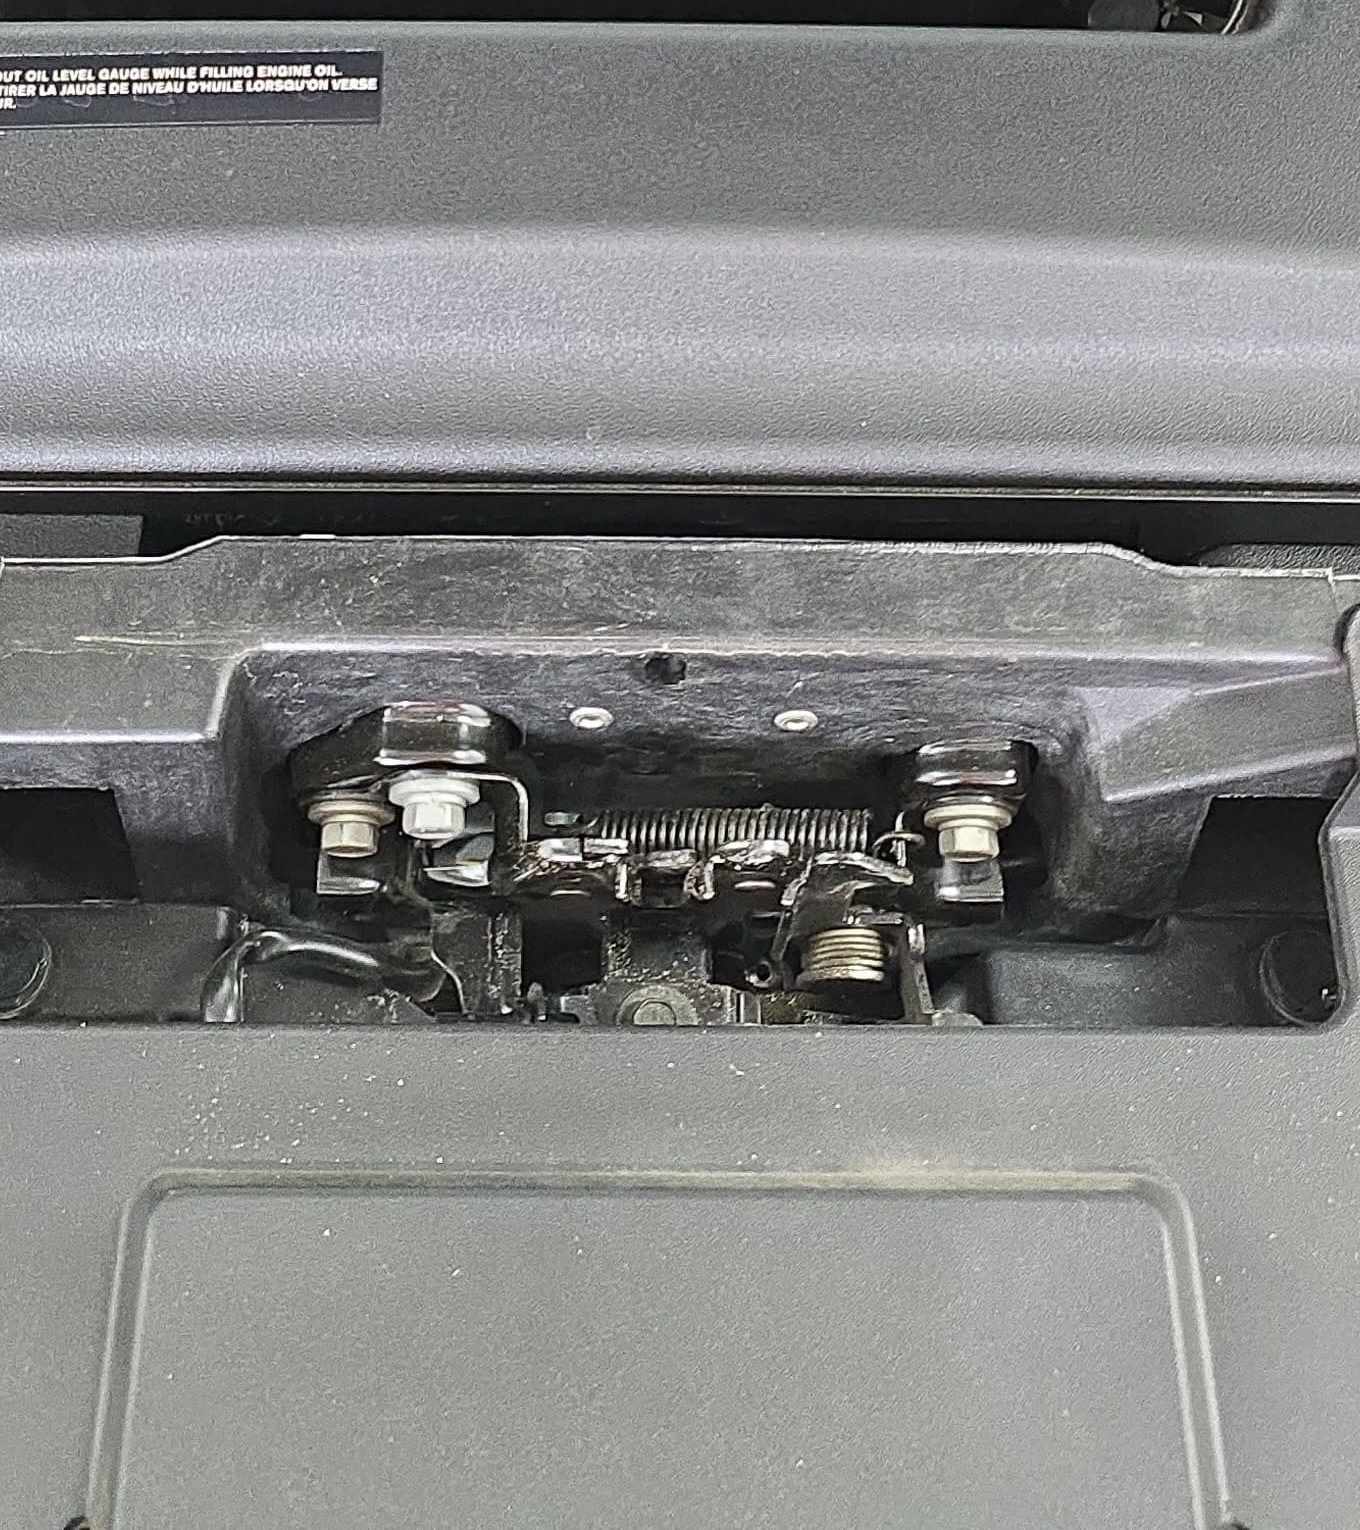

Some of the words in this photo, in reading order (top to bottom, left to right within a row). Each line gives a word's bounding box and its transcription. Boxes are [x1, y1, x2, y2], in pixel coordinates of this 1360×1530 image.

[25, 70, 49, 82] OIL
[52, 69, 95, 81] LEVEL
[98, 67, 150, 80] GAUGE
[152, 67, 197, 79] WHILE
[199, 65, 254, 78] FILLING
[257, 65, 312, 77] ENGINE
[314, 64, 343, 76] OIL.
[40, 84, 57, 96] LA
[59, 83, 106, 96] JAUGE
[109, 82, 129, 95] DE
[132, 81, 184, 94] NIVEAU
[187, 80, 243, 93] D'HUILE
[331, 78, 378, 91] VERSE
